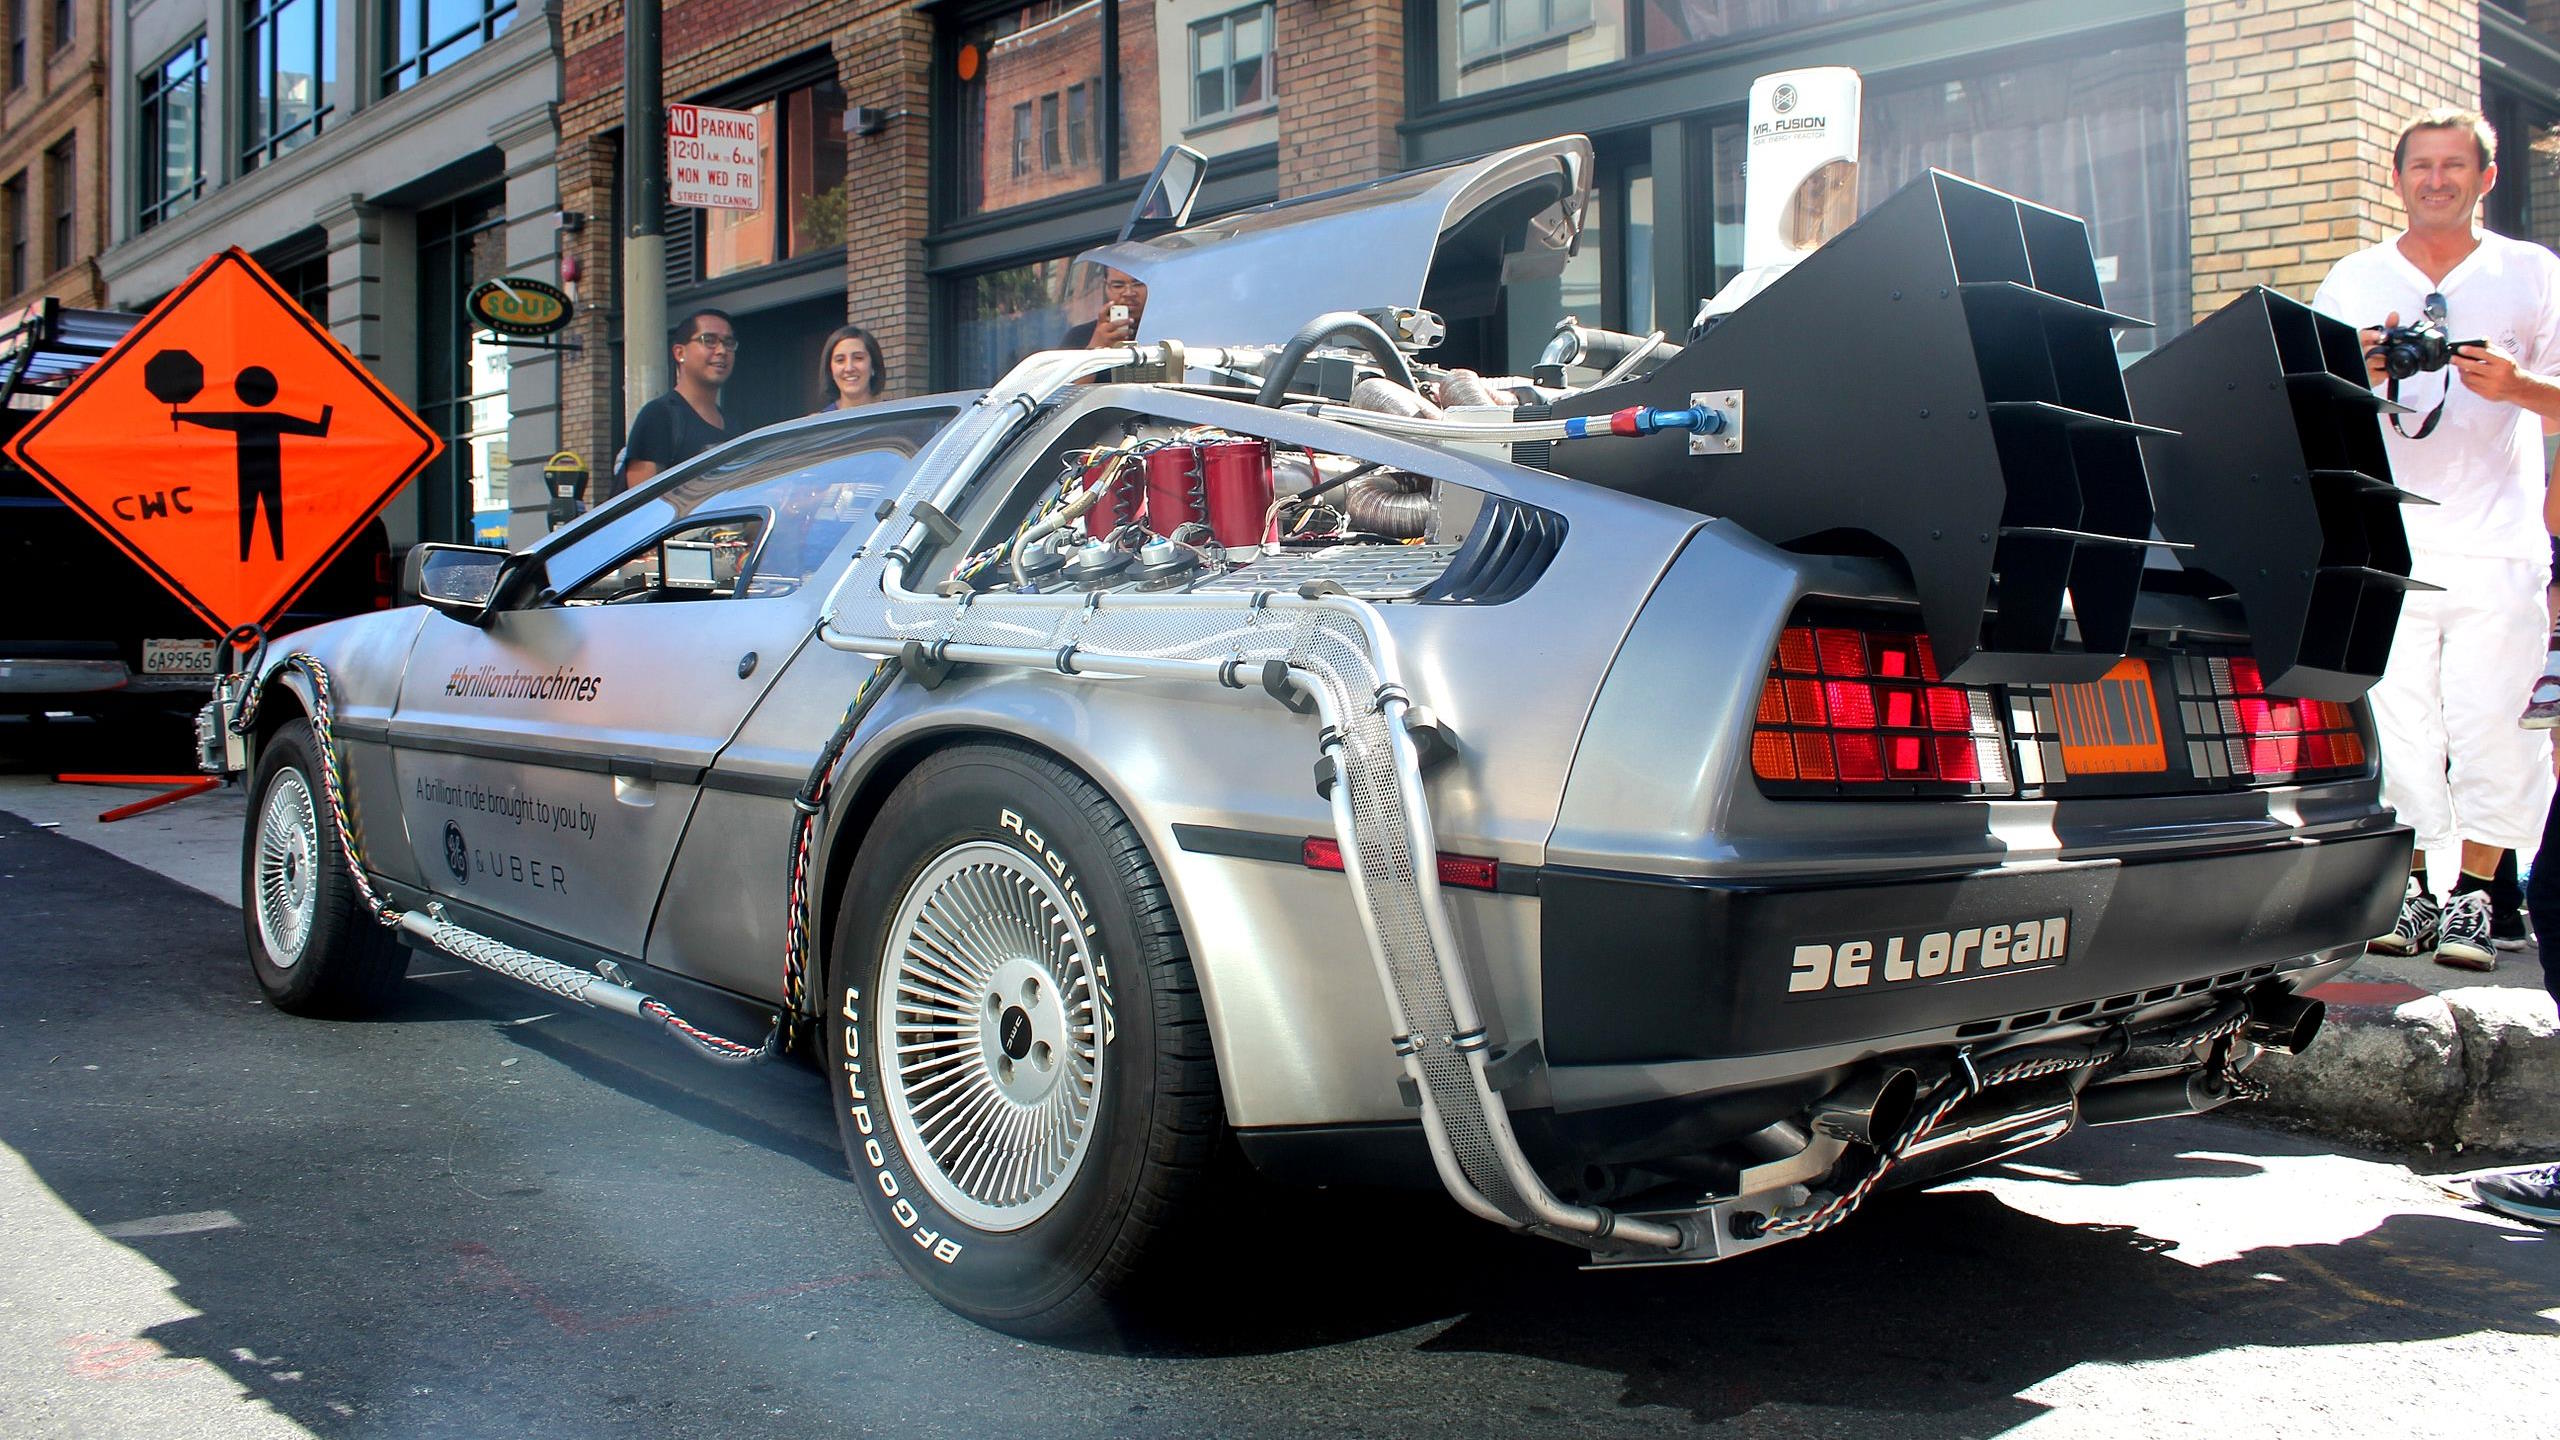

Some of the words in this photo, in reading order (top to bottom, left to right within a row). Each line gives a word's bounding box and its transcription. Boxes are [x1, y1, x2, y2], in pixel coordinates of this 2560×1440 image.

[672, 109, 695, 134] NO
[701, 118, 754, 141] PARKING
[1753, 123, 1771, 136] MR.
[1776, 116, 1826, 131] FUSION
[673, 141, 704, 160] 12:01
[677, 167, 699, 184] MON
[707, 170, 728, 187] WED
[737, 173, 752, 189] FRI
[677, 192, 708, 204] STREET
[713, 194, 752, 207] CLEANING
[487, 295, 557, 317] SOUP
[112, 486, 193, 521] CWC
[147, 652, 212, 669] 6A99565
[444, 663, 602, 702] #brilliantmachines
[416, 777, 423, 799] A
[426, 778, 462, 808] brilliant
[465, 784, 485, 811] ride
[488, 785, 535, 825] brought
[536, 799, 550, 824] to
[552, 805, 576, 832] you
[580, 802, 597, 840] by
[490, 851, 567, 895] UBER
[1000, 807, 1096, 937] Radial
[1096, 954, 1117, 1047] T/A
[842, 986, 964, 1265] BFGoodrich
